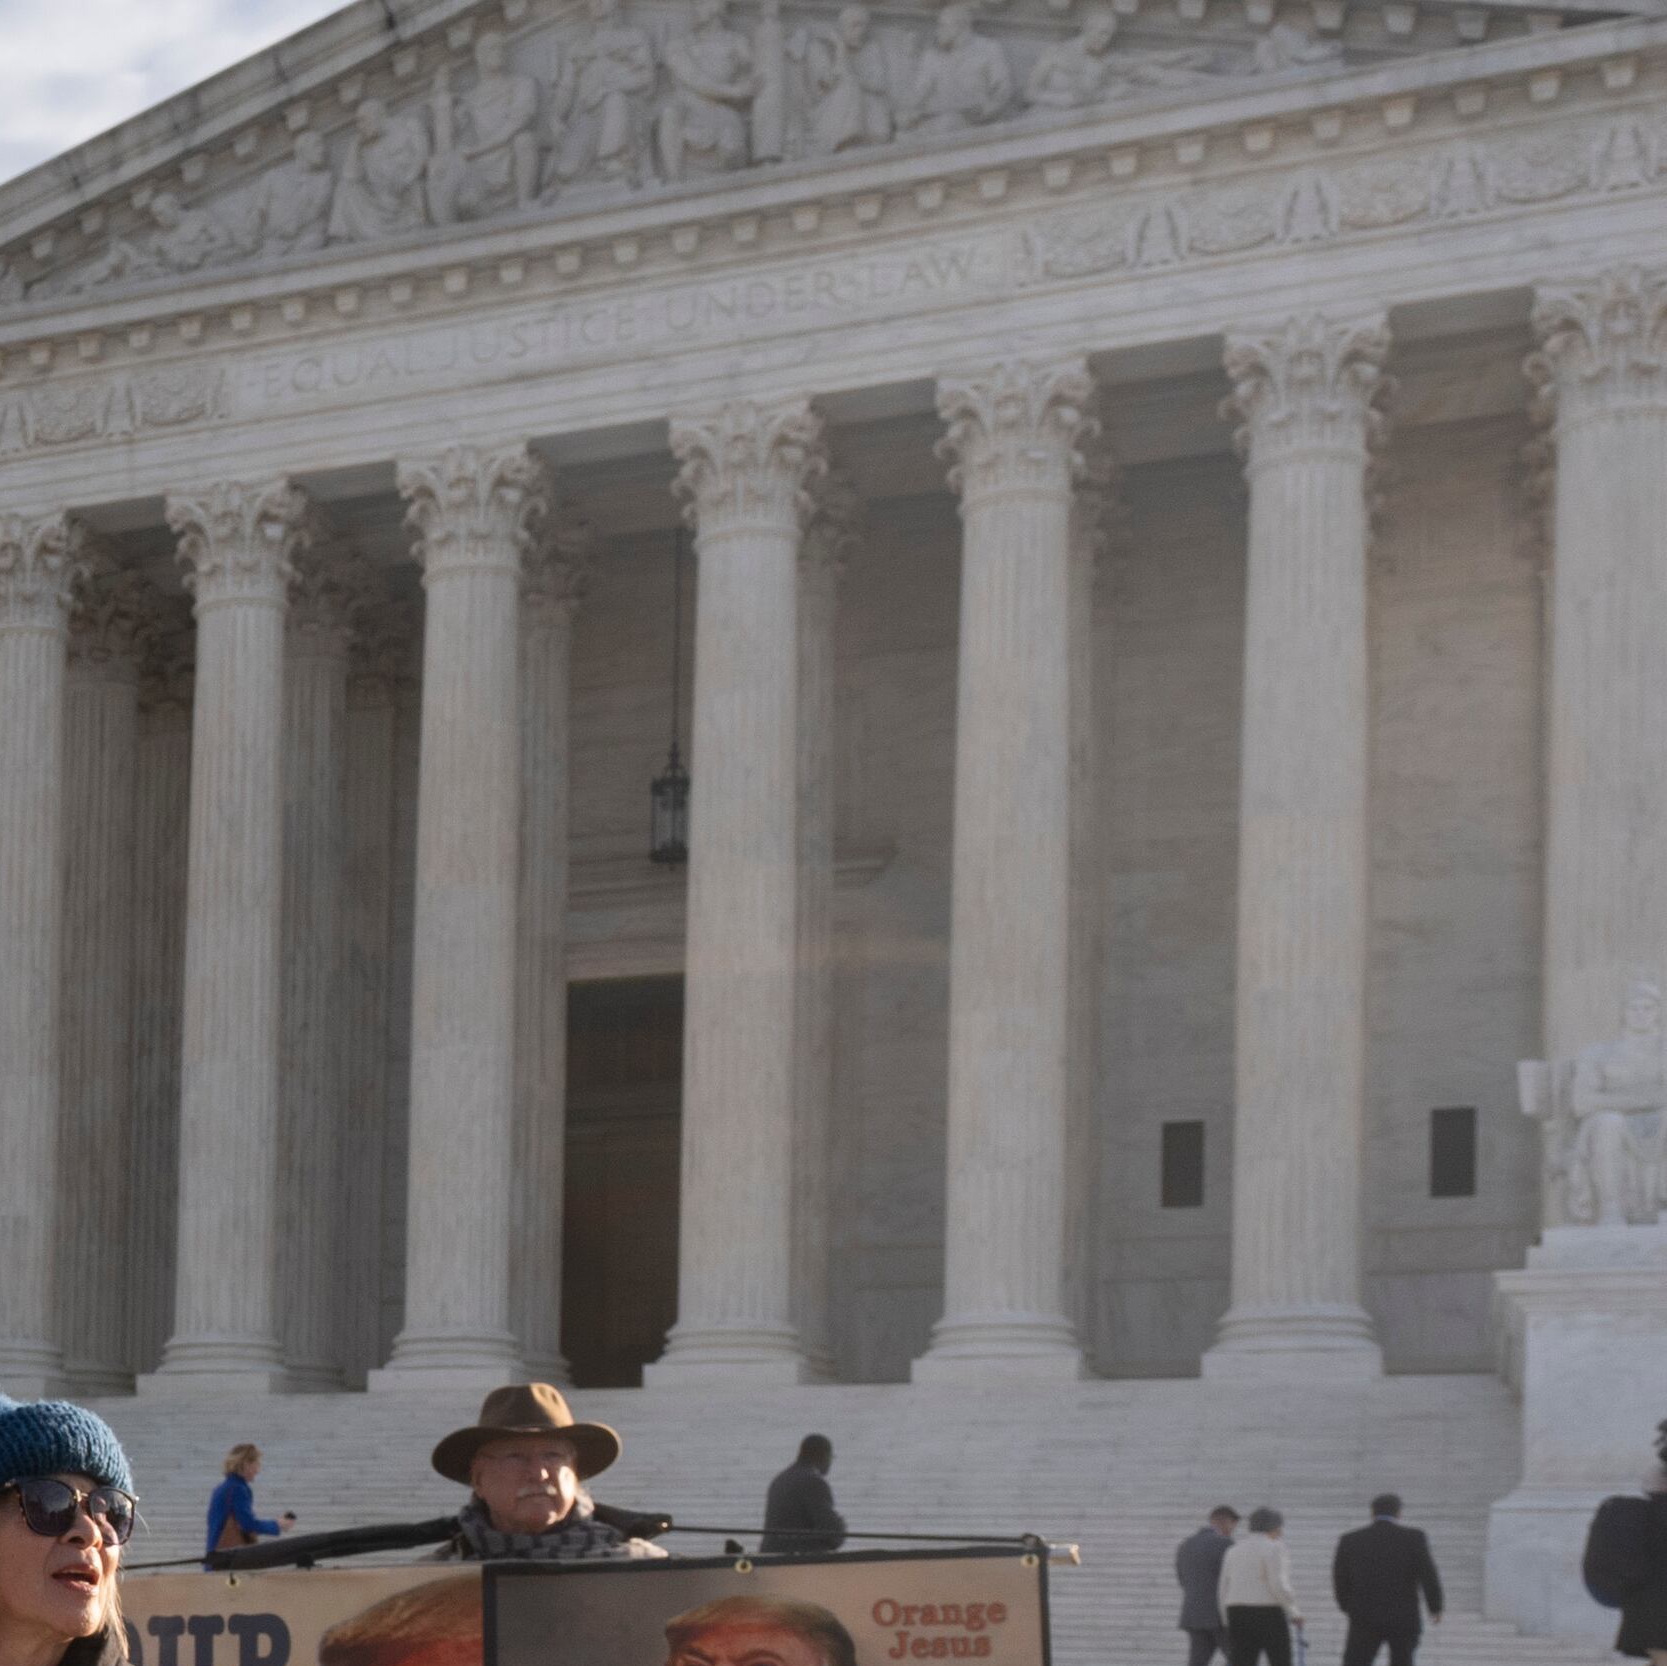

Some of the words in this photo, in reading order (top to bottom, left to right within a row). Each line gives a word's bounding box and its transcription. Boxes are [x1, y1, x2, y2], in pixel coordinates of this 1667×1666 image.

[264, 342, 428, 400] EQUAL
[433, 305, 634, 373] JUSTICE
[666, 271, 844, 331] UNDER
[868, 250, 973, 297] LAW
[871, 1598, 1008, 1632] Orange
[888, 1630, 992, 1660] Jesus
